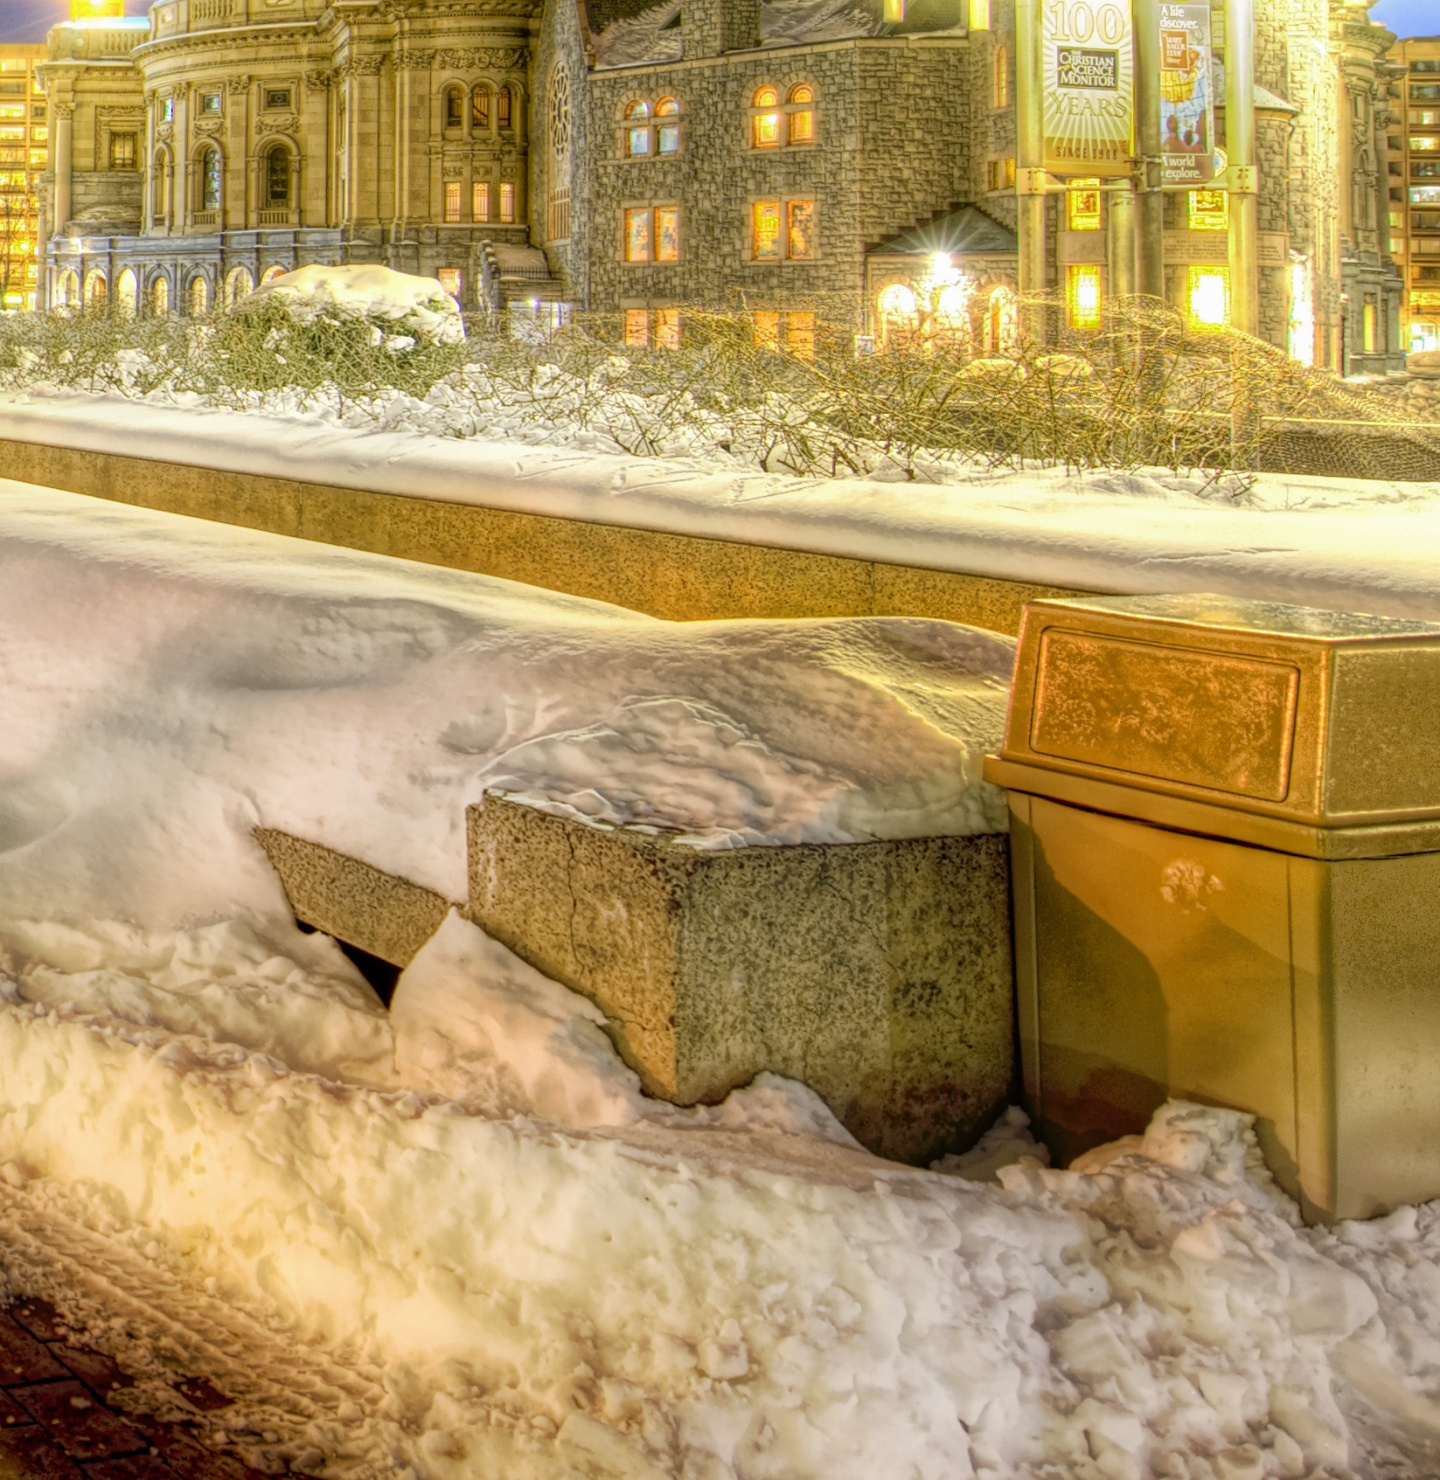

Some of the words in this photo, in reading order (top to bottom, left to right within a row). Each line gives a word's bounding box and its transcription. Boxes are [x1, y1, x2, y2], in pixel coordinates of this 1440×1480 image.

[1161, 5, 1168, 16] A
[1170, 5, 1184, 17] life
[1051, 1, 1124, 45] 100
[1060, 52, 1115, 67] CHRISTIAN
[1071, 64, 1114, 76] SCIENCE
[1061, 71, 1116, 87] MONITOR
[1049, 91, 1127, 119] YEARS
[1056, 146, 1088, 159] SINCE
[1169, 155, 1195, 167] world
[1165, 167, 1202, 181] explore.
